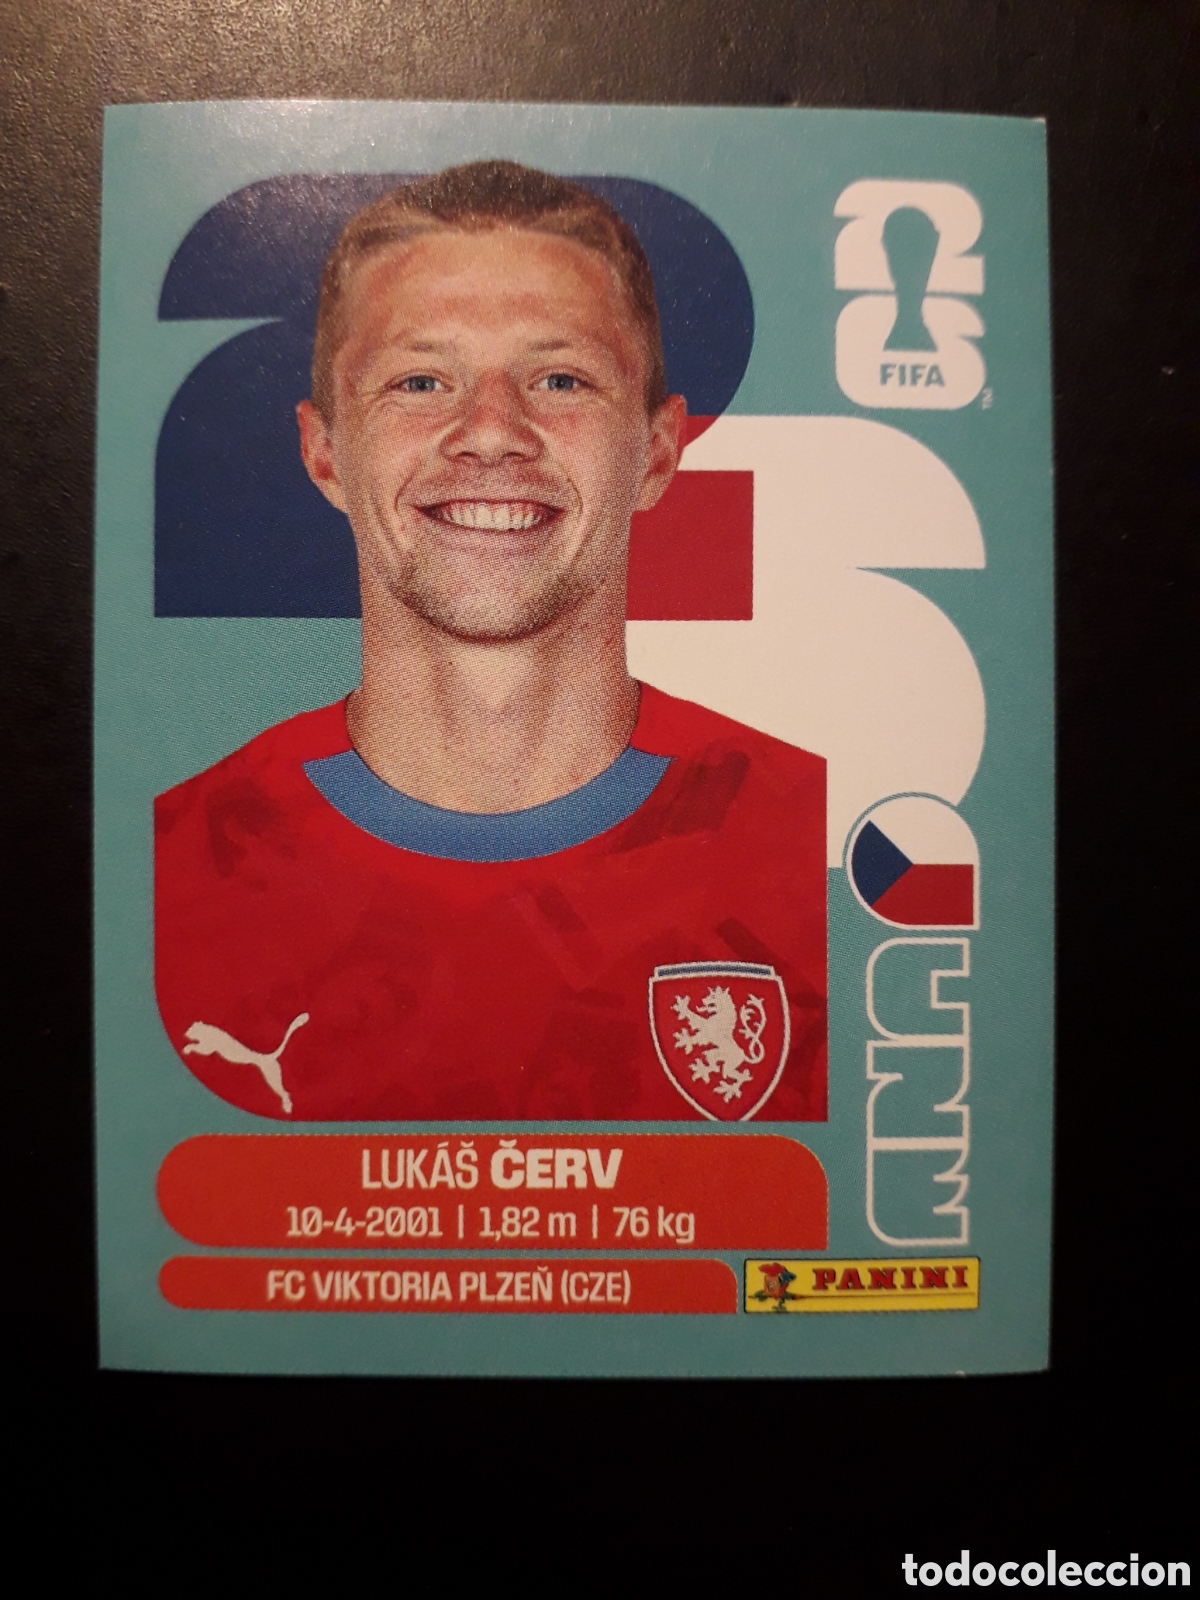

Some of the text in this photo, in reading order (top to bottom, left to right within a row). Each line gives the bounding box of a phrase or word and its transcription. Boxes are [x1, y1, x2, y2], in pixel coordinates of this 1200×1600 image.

[880, 364, 945, 388] FIFA
[361, 1139, 623, 1190] LUKÁŠ ČERV
[286, 1206, 443, 1238] 10-4-2001
[479, 1206, 540, 1241] 1,82
[548, 1212, 577, 1237] m
[612, 1206, 649, 1238] 76
[657, 1206, 695, 1244] kg
[267, 1265, 631, 1305] FC VIKTORIA PLZEŇ (CZE)
[812, 1265, 968, 1291] PANINI
